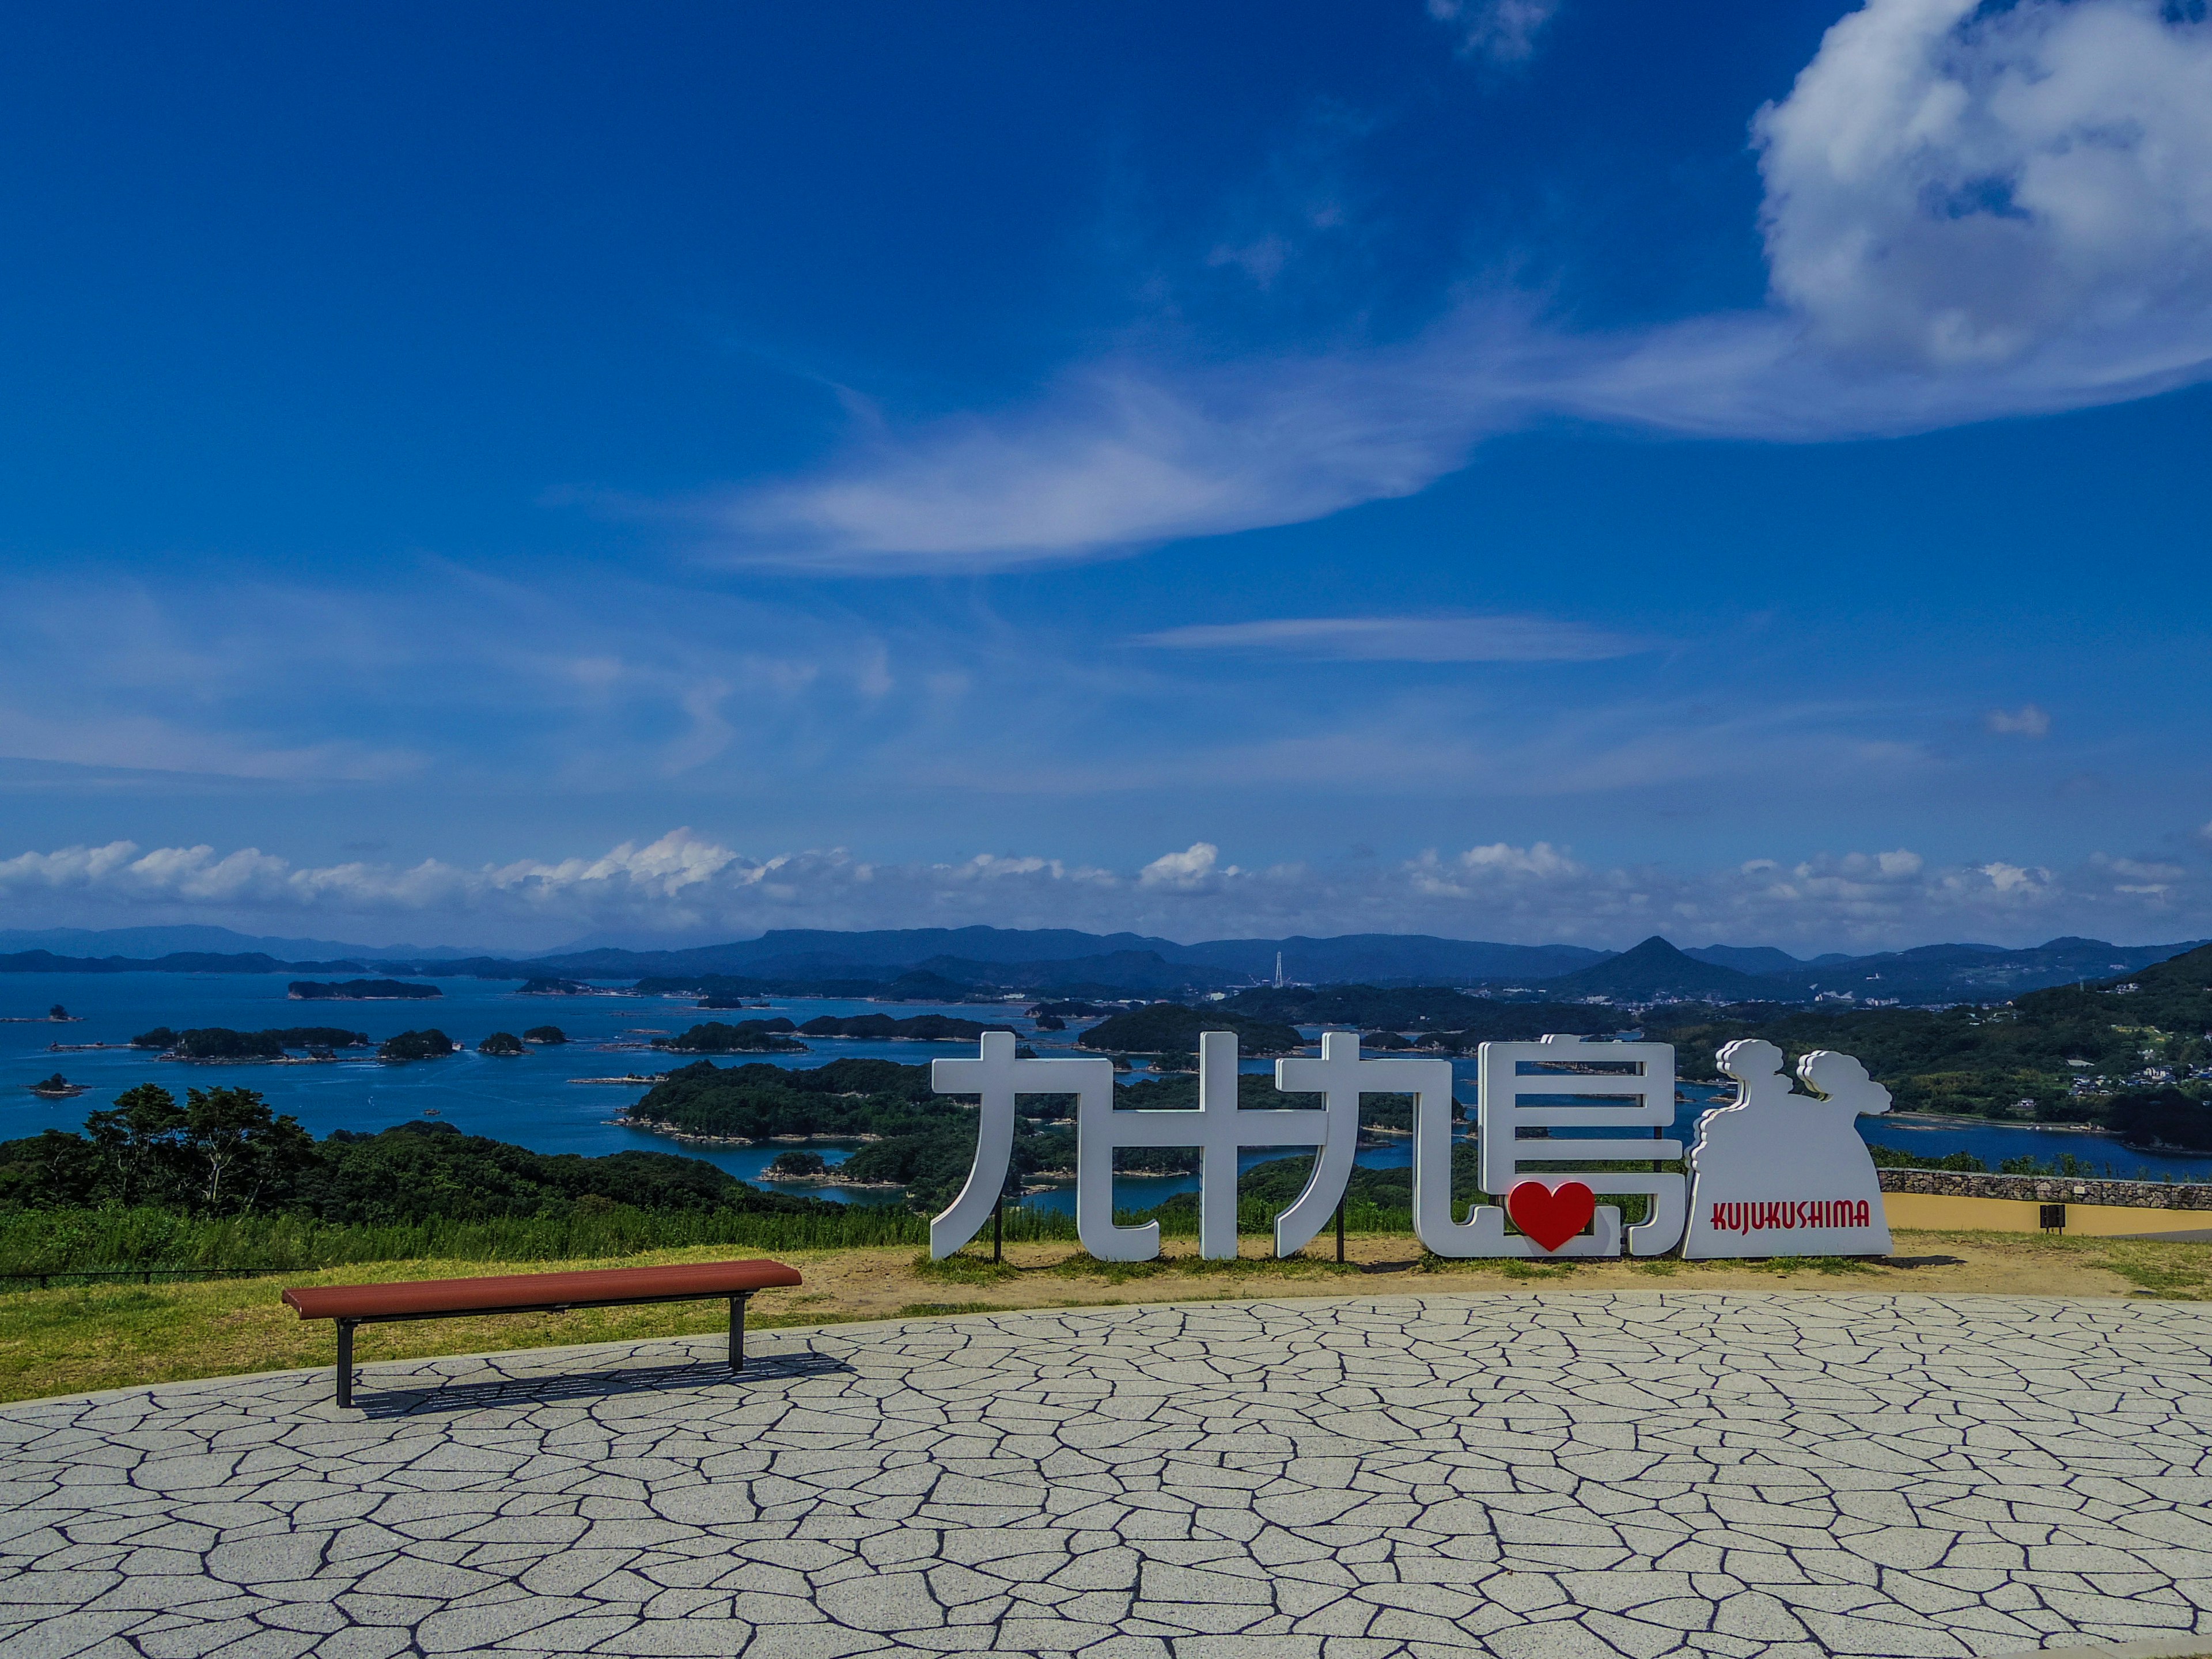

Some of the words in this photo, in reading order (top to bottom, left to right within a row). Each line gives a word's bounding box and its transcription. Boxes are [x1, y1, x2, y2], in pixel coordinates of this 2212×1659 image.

[930, 1031, 1685, 1262] 九十九島
[1710, 1199, 1870, 1236] KUJUKUSHIMA
